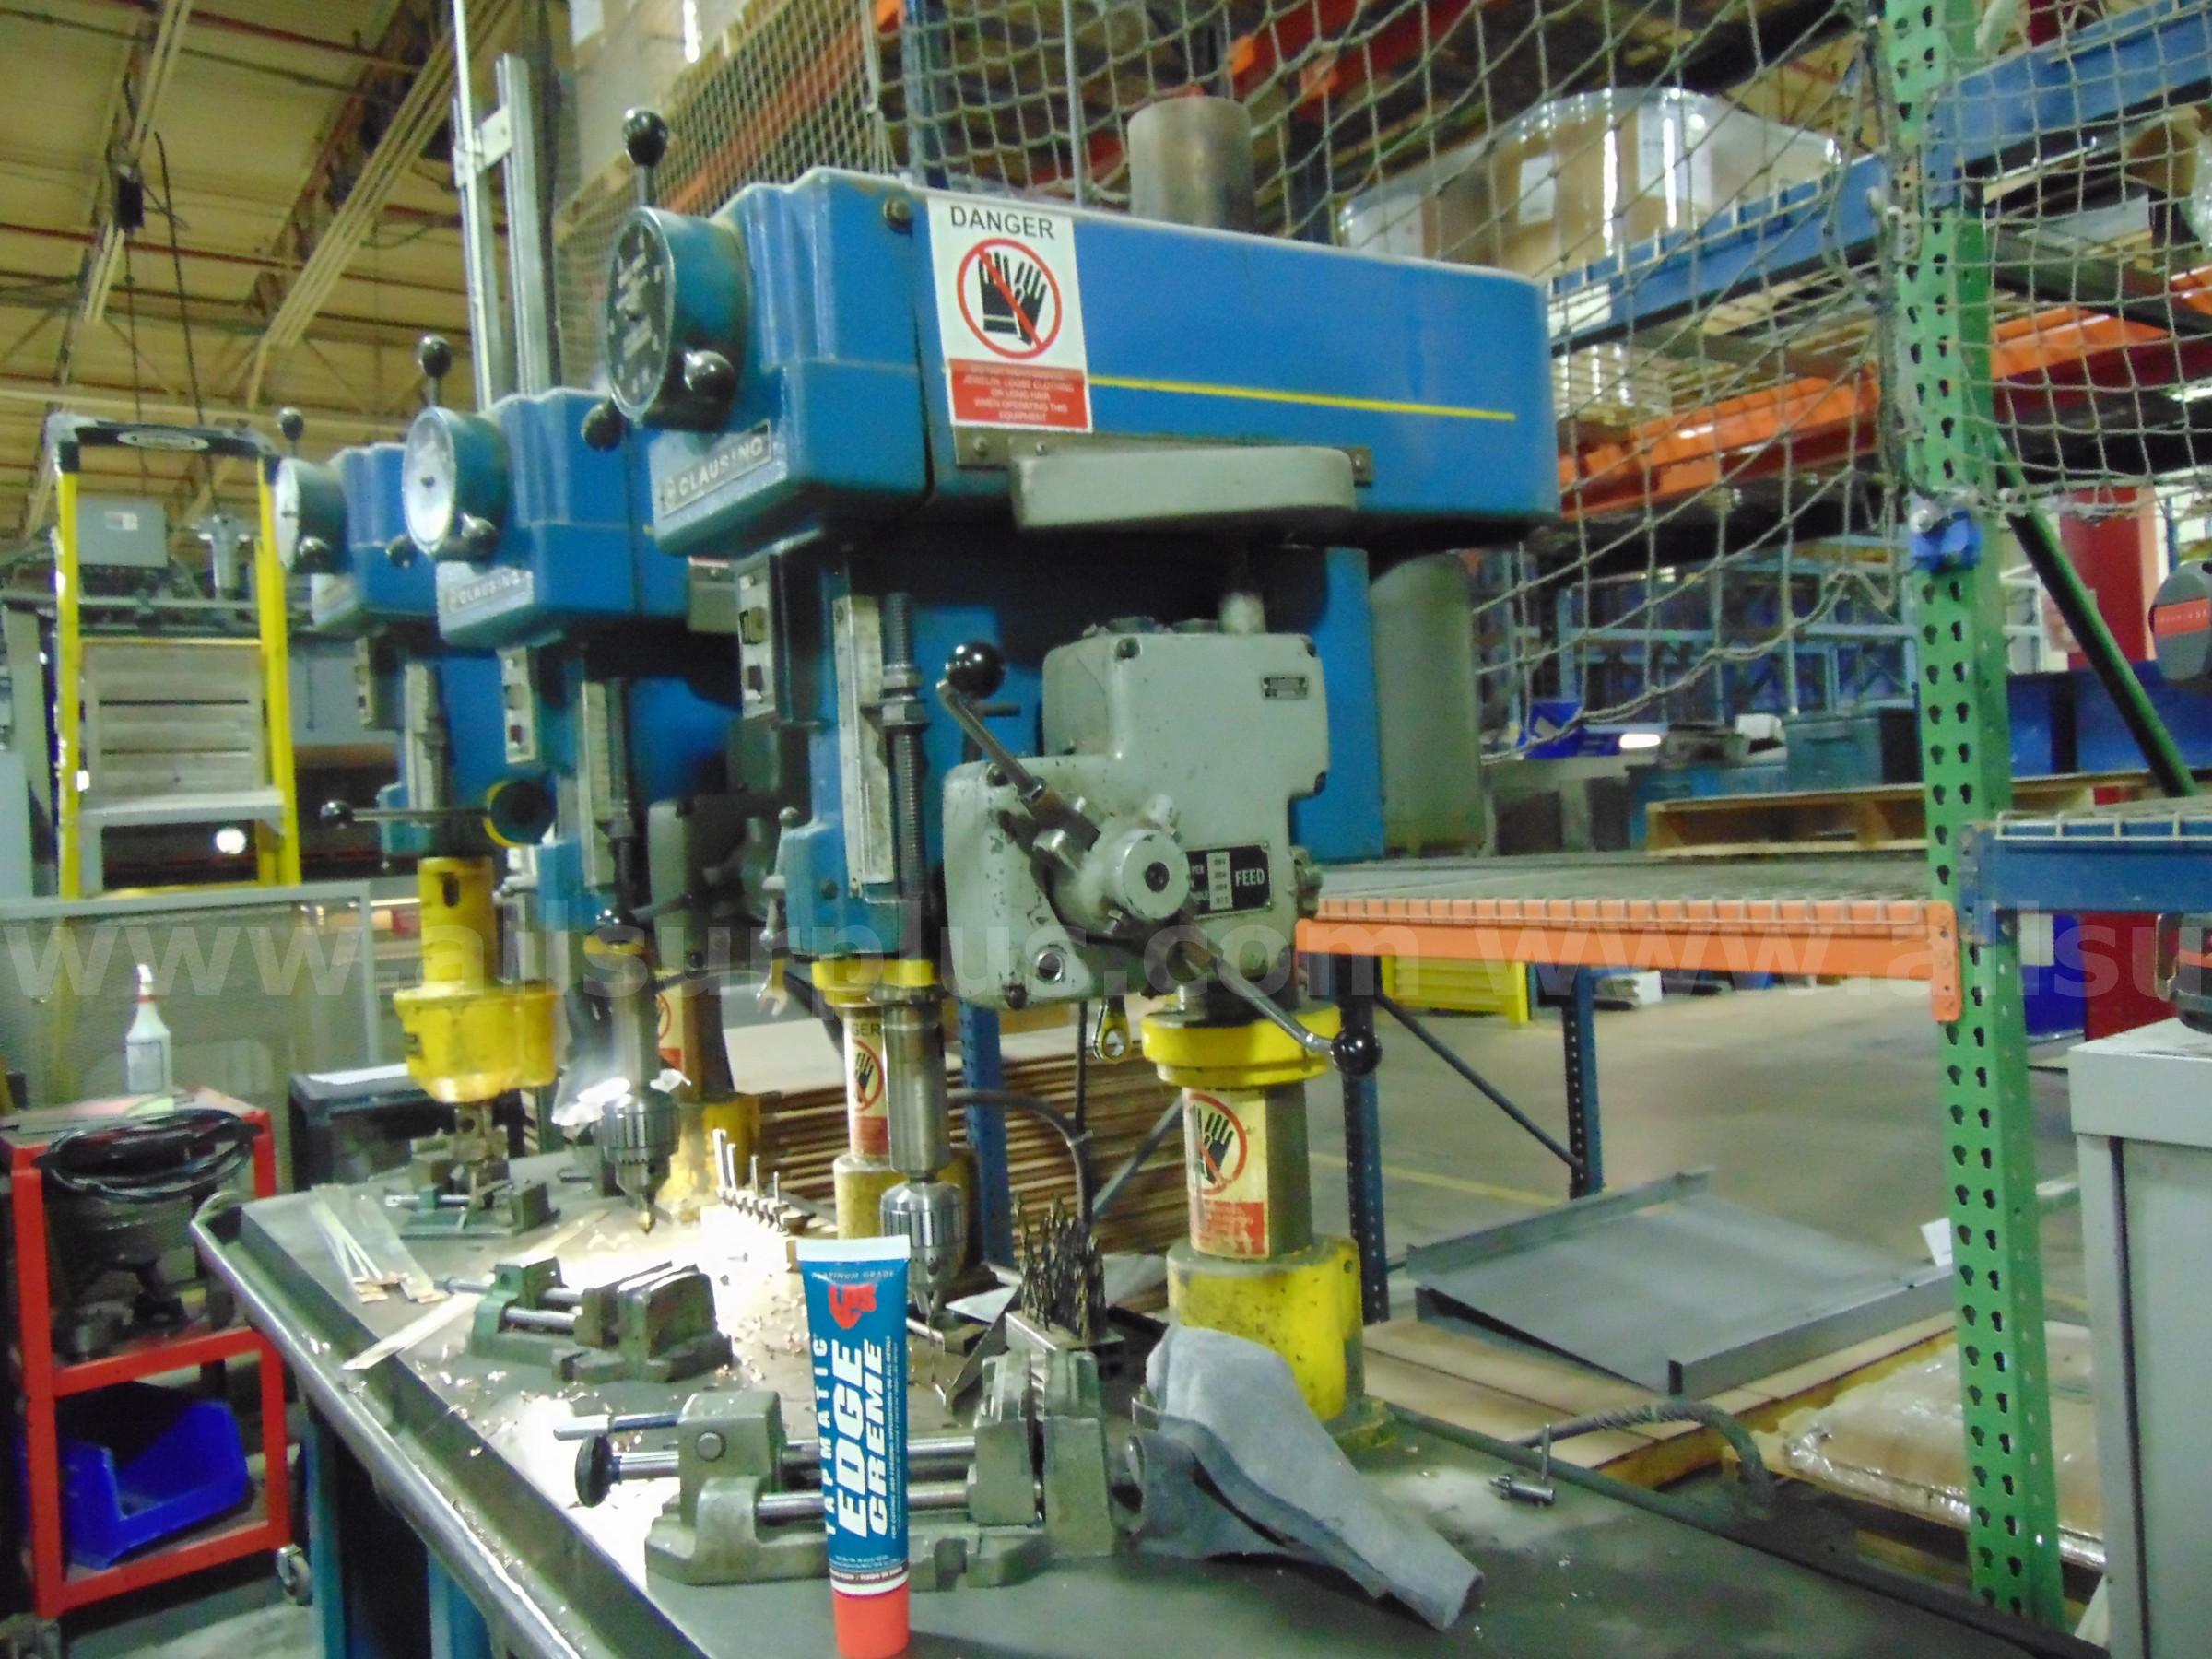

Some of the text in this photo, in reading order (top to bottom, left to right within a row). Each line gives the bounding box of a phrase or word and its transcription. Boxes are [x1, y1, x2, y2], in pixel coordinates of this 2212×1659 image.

[950, 206, 1054, 240] DANGER
[678, 436, 764, 497] CLAUSING
[1235, 868, 1265, 887] FEED
[812, 1337, 837, 1535] TAPMATIC
[831, 1338, 868, 1539] EDGE
[864, 1337, 888, 1537] CREME
